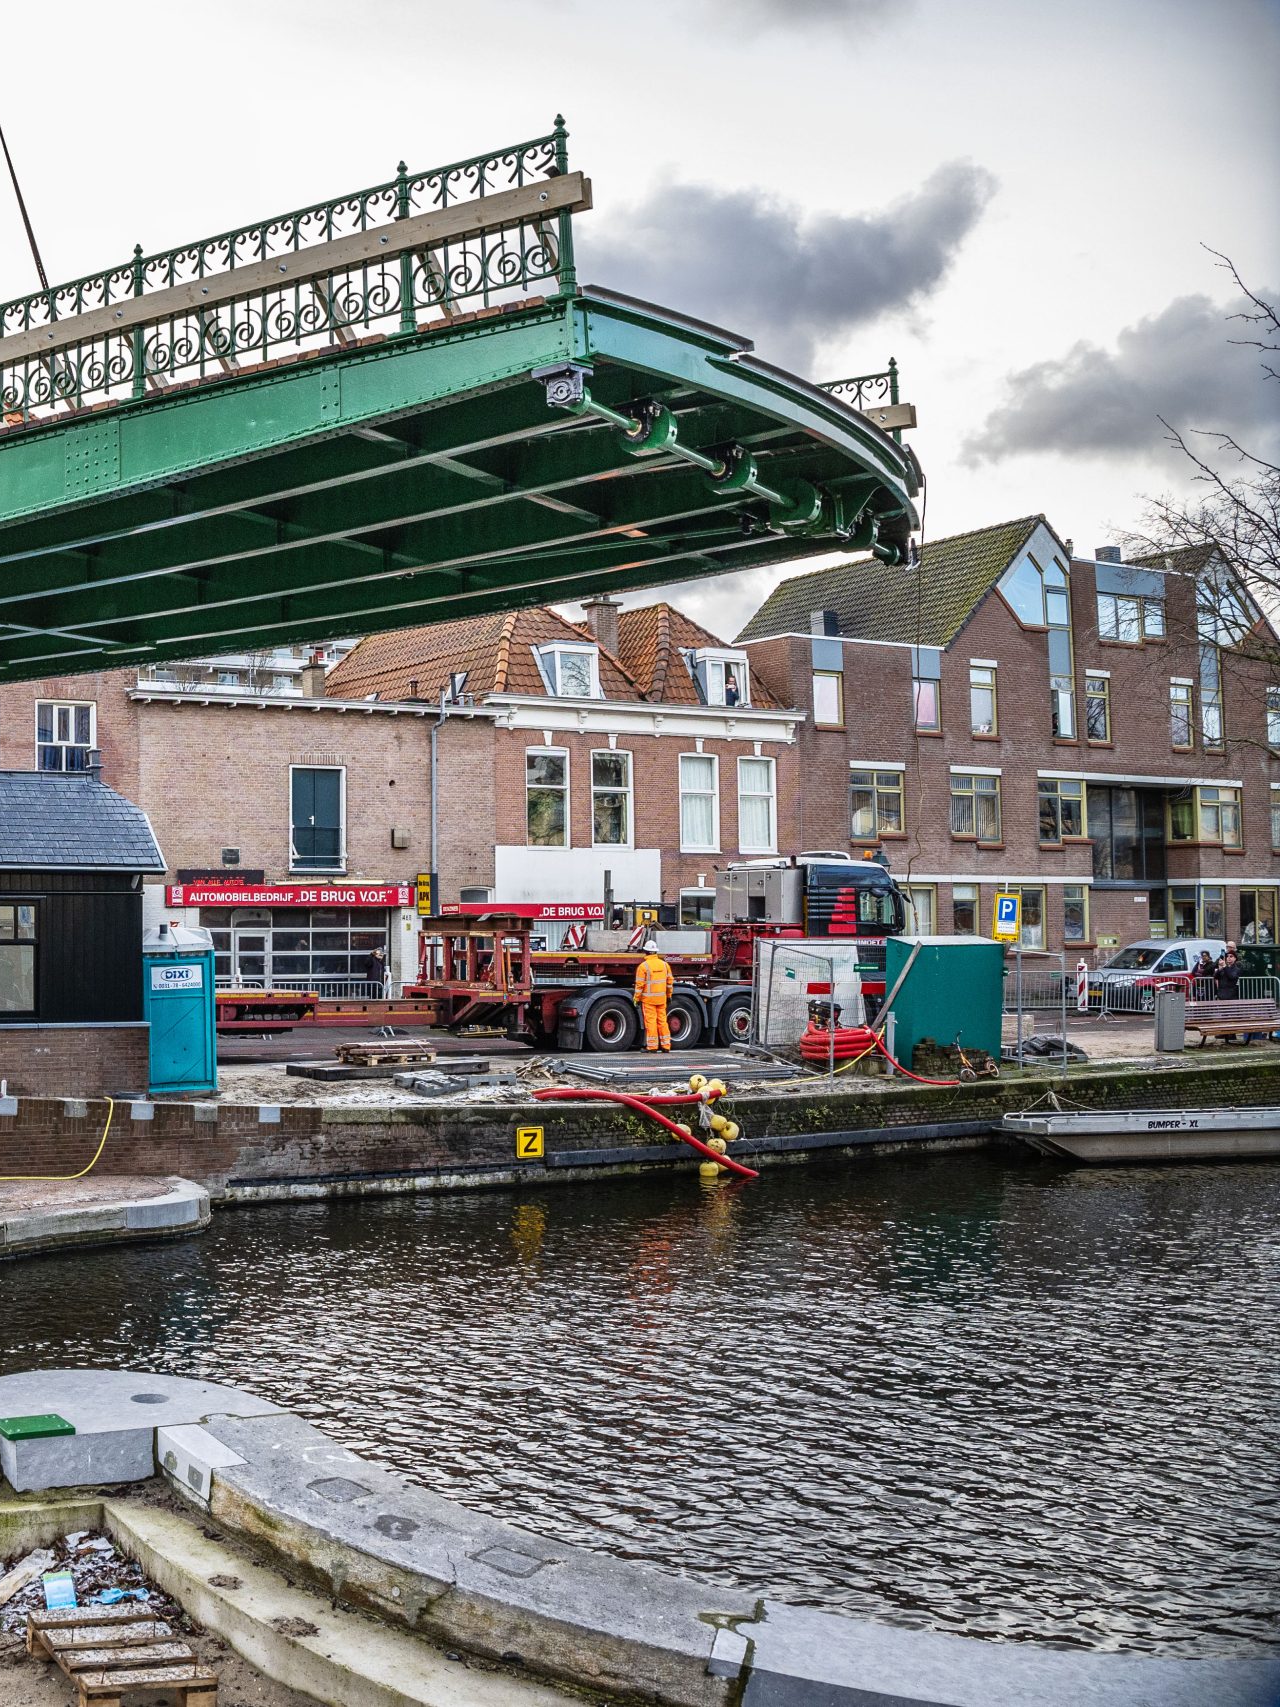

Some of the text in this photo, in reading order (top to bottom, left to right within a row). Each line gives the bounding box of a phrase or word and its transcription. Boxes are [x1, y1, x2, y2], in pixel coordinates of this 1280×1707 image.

[189, 892, 294, 902] AUTOMOBIELBEDRIJF
[320, 890, 356, 902] BRUG
[419, 891, 430, 901] APK
[558, 907, 585, 916] BRUG
[1001, 900, 1014, 919] P
[1147, 1120, 1181, 1129] BUMPER
[1189, 1119, 1200, 1128] XL
[523, 1132, 538, 1153] Z
